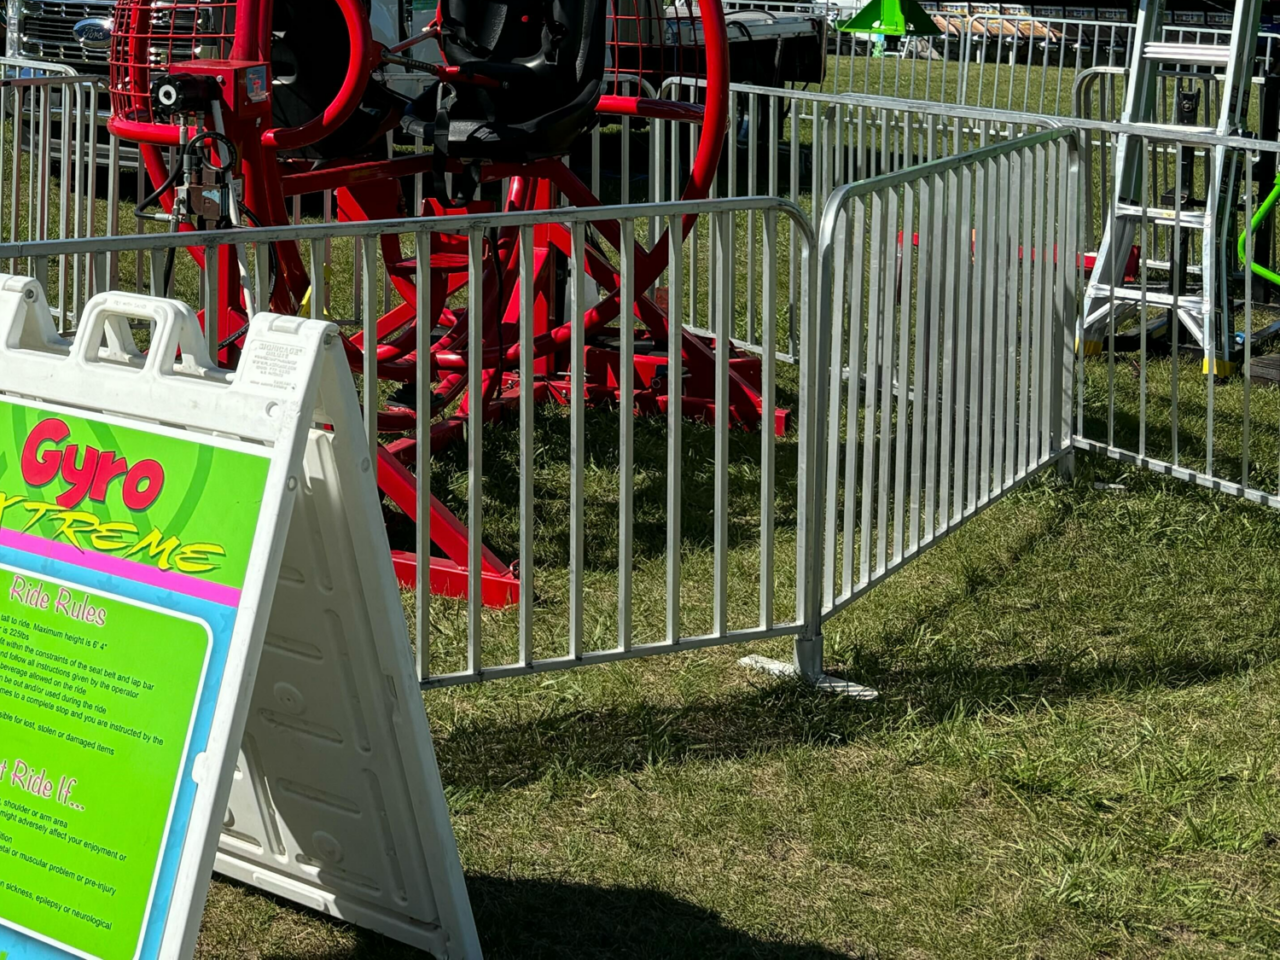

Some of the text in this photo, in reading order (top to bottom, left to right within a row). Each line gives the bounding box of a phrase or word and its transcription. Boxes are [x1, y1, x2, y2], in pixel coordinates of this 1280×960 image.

[83, 26, 104, 39] Ford
[21, 417, 165, 511] Gyro
[10, 574, 108, 627] Ride Rules
[0, 613, 10, 623] tall
[10, 616, 18, 625] to
[32, 622, 63, 638] Maximum
[64, 632, 85, 645] height
[84, 638, 91, 647] is
[8, 627, 29, 641] 225lbs
[0, 662, 28, 677] beverage
[28, 671, 53, 685] allowed
[52, 679, 62, 687] on
[62, 681, 73, 691] the
[73, 685, 87, 696] ride
[5, 640, 23, 650] within
[23, 644, 34, 655] the
[34, 649, 68, 665] constraints
[69, 658, 77, 667] of
[76, 661, 88, 671] the
[88, 665, 103, 675] seat
[103, 668, 116, 679] belt
[116, 674, 131, 684] and
[130, 677, 142, 688] lap
[142, 680, 154, 690] bar
[8, 651, 27, 664] follow
[26, 658, 35, 667] all
[35, 662, 71, 678] instructions
[71, 672, 89, 683] given
[89, 677, 99, 688] by
[99, 680, 110, 690] the
[110, 685, 139, 698] operator
[3, 675, 13, 684] be
[12, 679, 24, 688] out
[23, 682, 44, 694] and/or
[44, 689, 61, 700] used
[60, 693, 82, 708] during
[82, 700, 93, 710] the
[93, 704, 107, 715] ride
[13, 714, 23, 724] for
[37, 724, 57, 735] stolen
[65, 732, 96, 749] damaged
[96, 743, 115, 756] items
[11, 758, 53, 799] Ride
[56, 775, 85, 812] If...
[3, 799, 31, 814] shoulder
[30, 809, 39, 817] or
[38, 812, 52, 822] arm
[52, 817, 68, 829] area
[0, 809, 17, 822] might
[17, 816, 48, 834] adversely
[48, 828, 67, 840] affect
[66, 835, 83, 845] your
[82, 841, 118, 859] enjoyment
[118, 853, 127, 861] or
[35, 894, 62, 912] epilepsy
[62, 905, 71, 913] or
[71, 909, 112, 930] neurological
